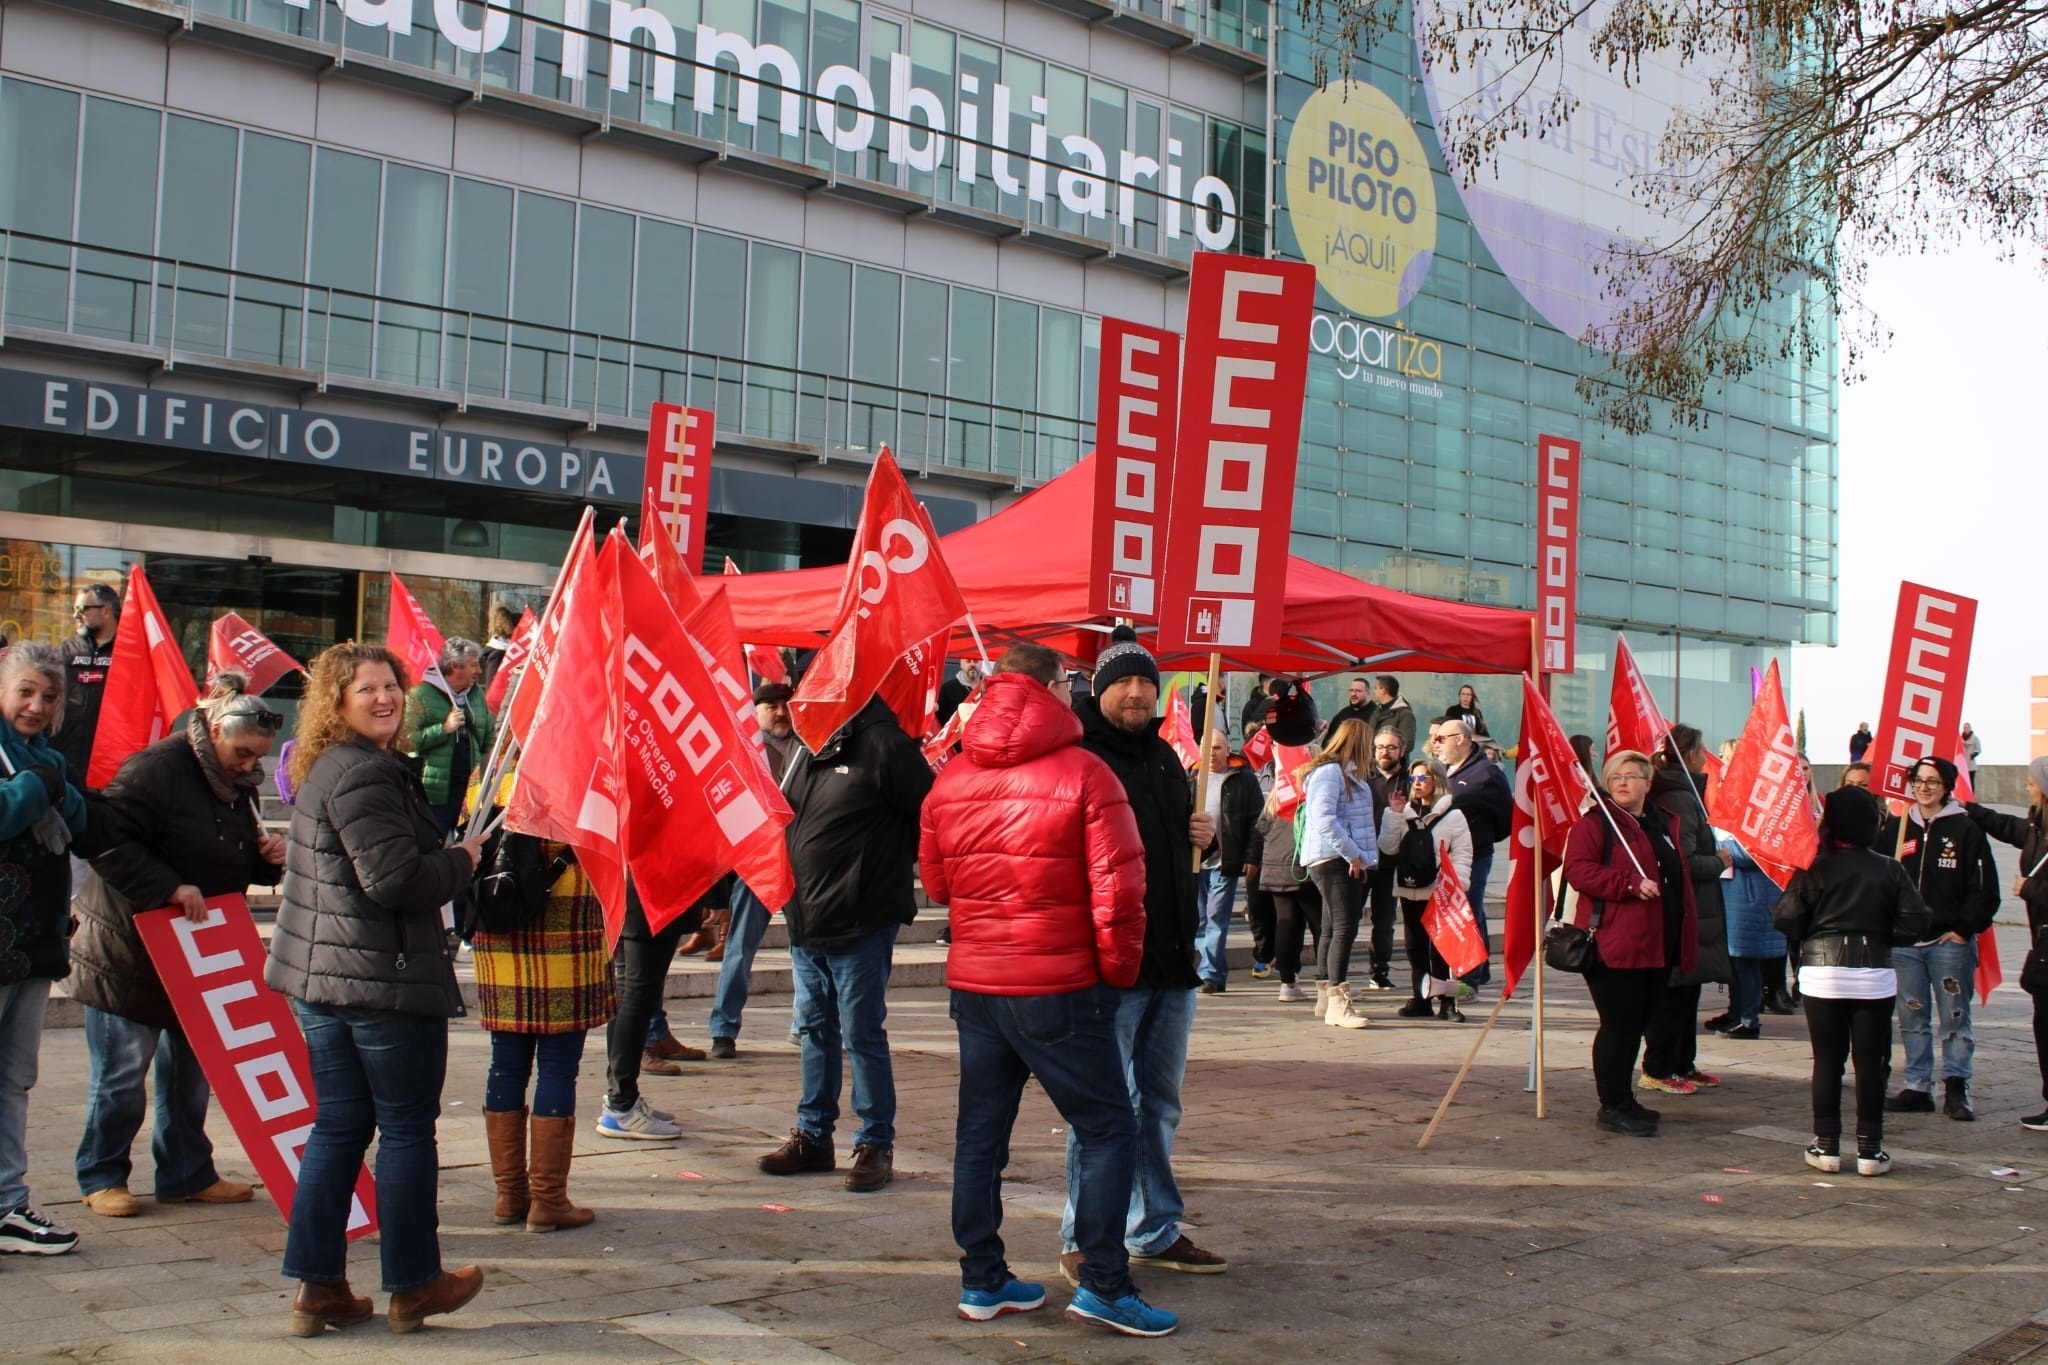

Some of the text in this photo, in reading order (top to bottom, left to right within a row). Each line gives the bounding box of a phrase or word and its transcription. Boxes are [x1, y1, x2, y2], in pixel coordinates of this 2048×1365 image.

[1328, 121, 1399, 177] PISO
[1308, 156, 1417, 224] PILOTO
[1325, 228, 1397, 275] ¡AQUÍ!
[1310, 315, 1442, 381] ogariza
[1363, 369, 1443, 400] tu nuevo mundo
[44, 381, 615, 495] EDIFICIO EUROPA
[1112, 332, 1160, 576] CCOO
[1195, 270, 1284, 594] CCOO
[1545, 445, 1570, 638] CCOO
[1890, 593, 1957, 767] CCOO
[638, 719, 678, 783] Obreras
[640, 743, 675, 810] Mancha
[1761, 779, 1798, 843] comisiones
[1771, 833, 1784, 849] de
